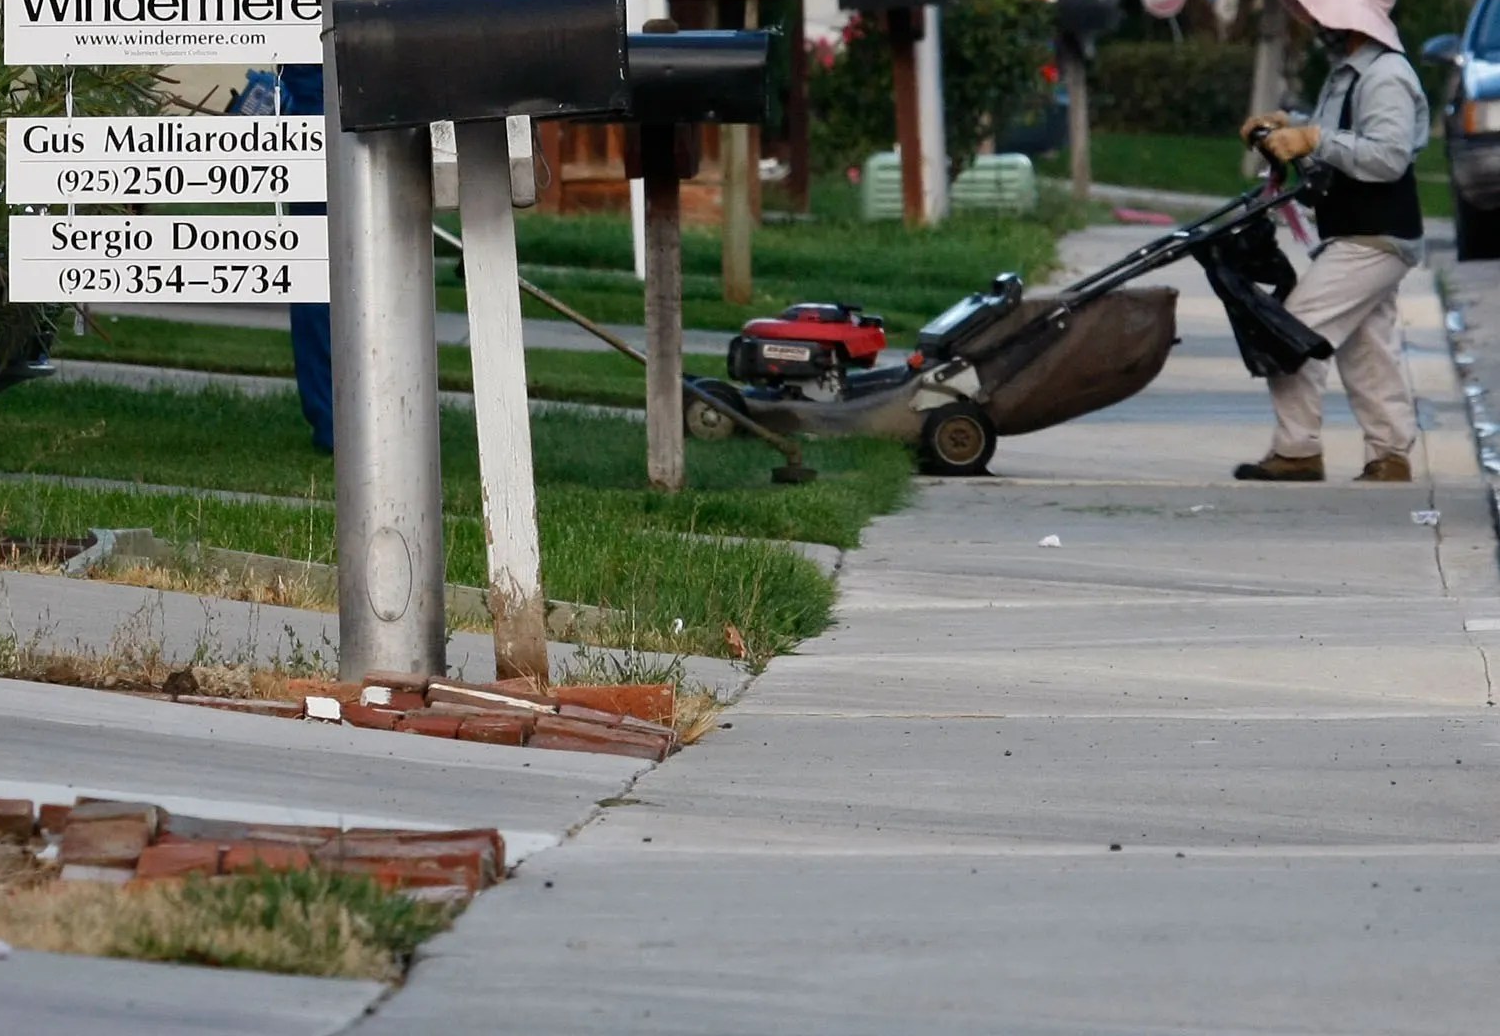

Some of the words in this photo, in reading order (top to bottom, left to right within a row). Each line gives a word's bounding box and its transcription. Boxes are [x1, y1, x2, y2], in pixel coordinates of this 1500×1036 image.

[75, 30, 266, 46] www.windermere.com
[23, 125, 85, 154] Gus
[104, 122, 323, 153] Malliarodakis
[52, 221, 153, 258] Sergio
[172, 222, 299, 251] Donoso
